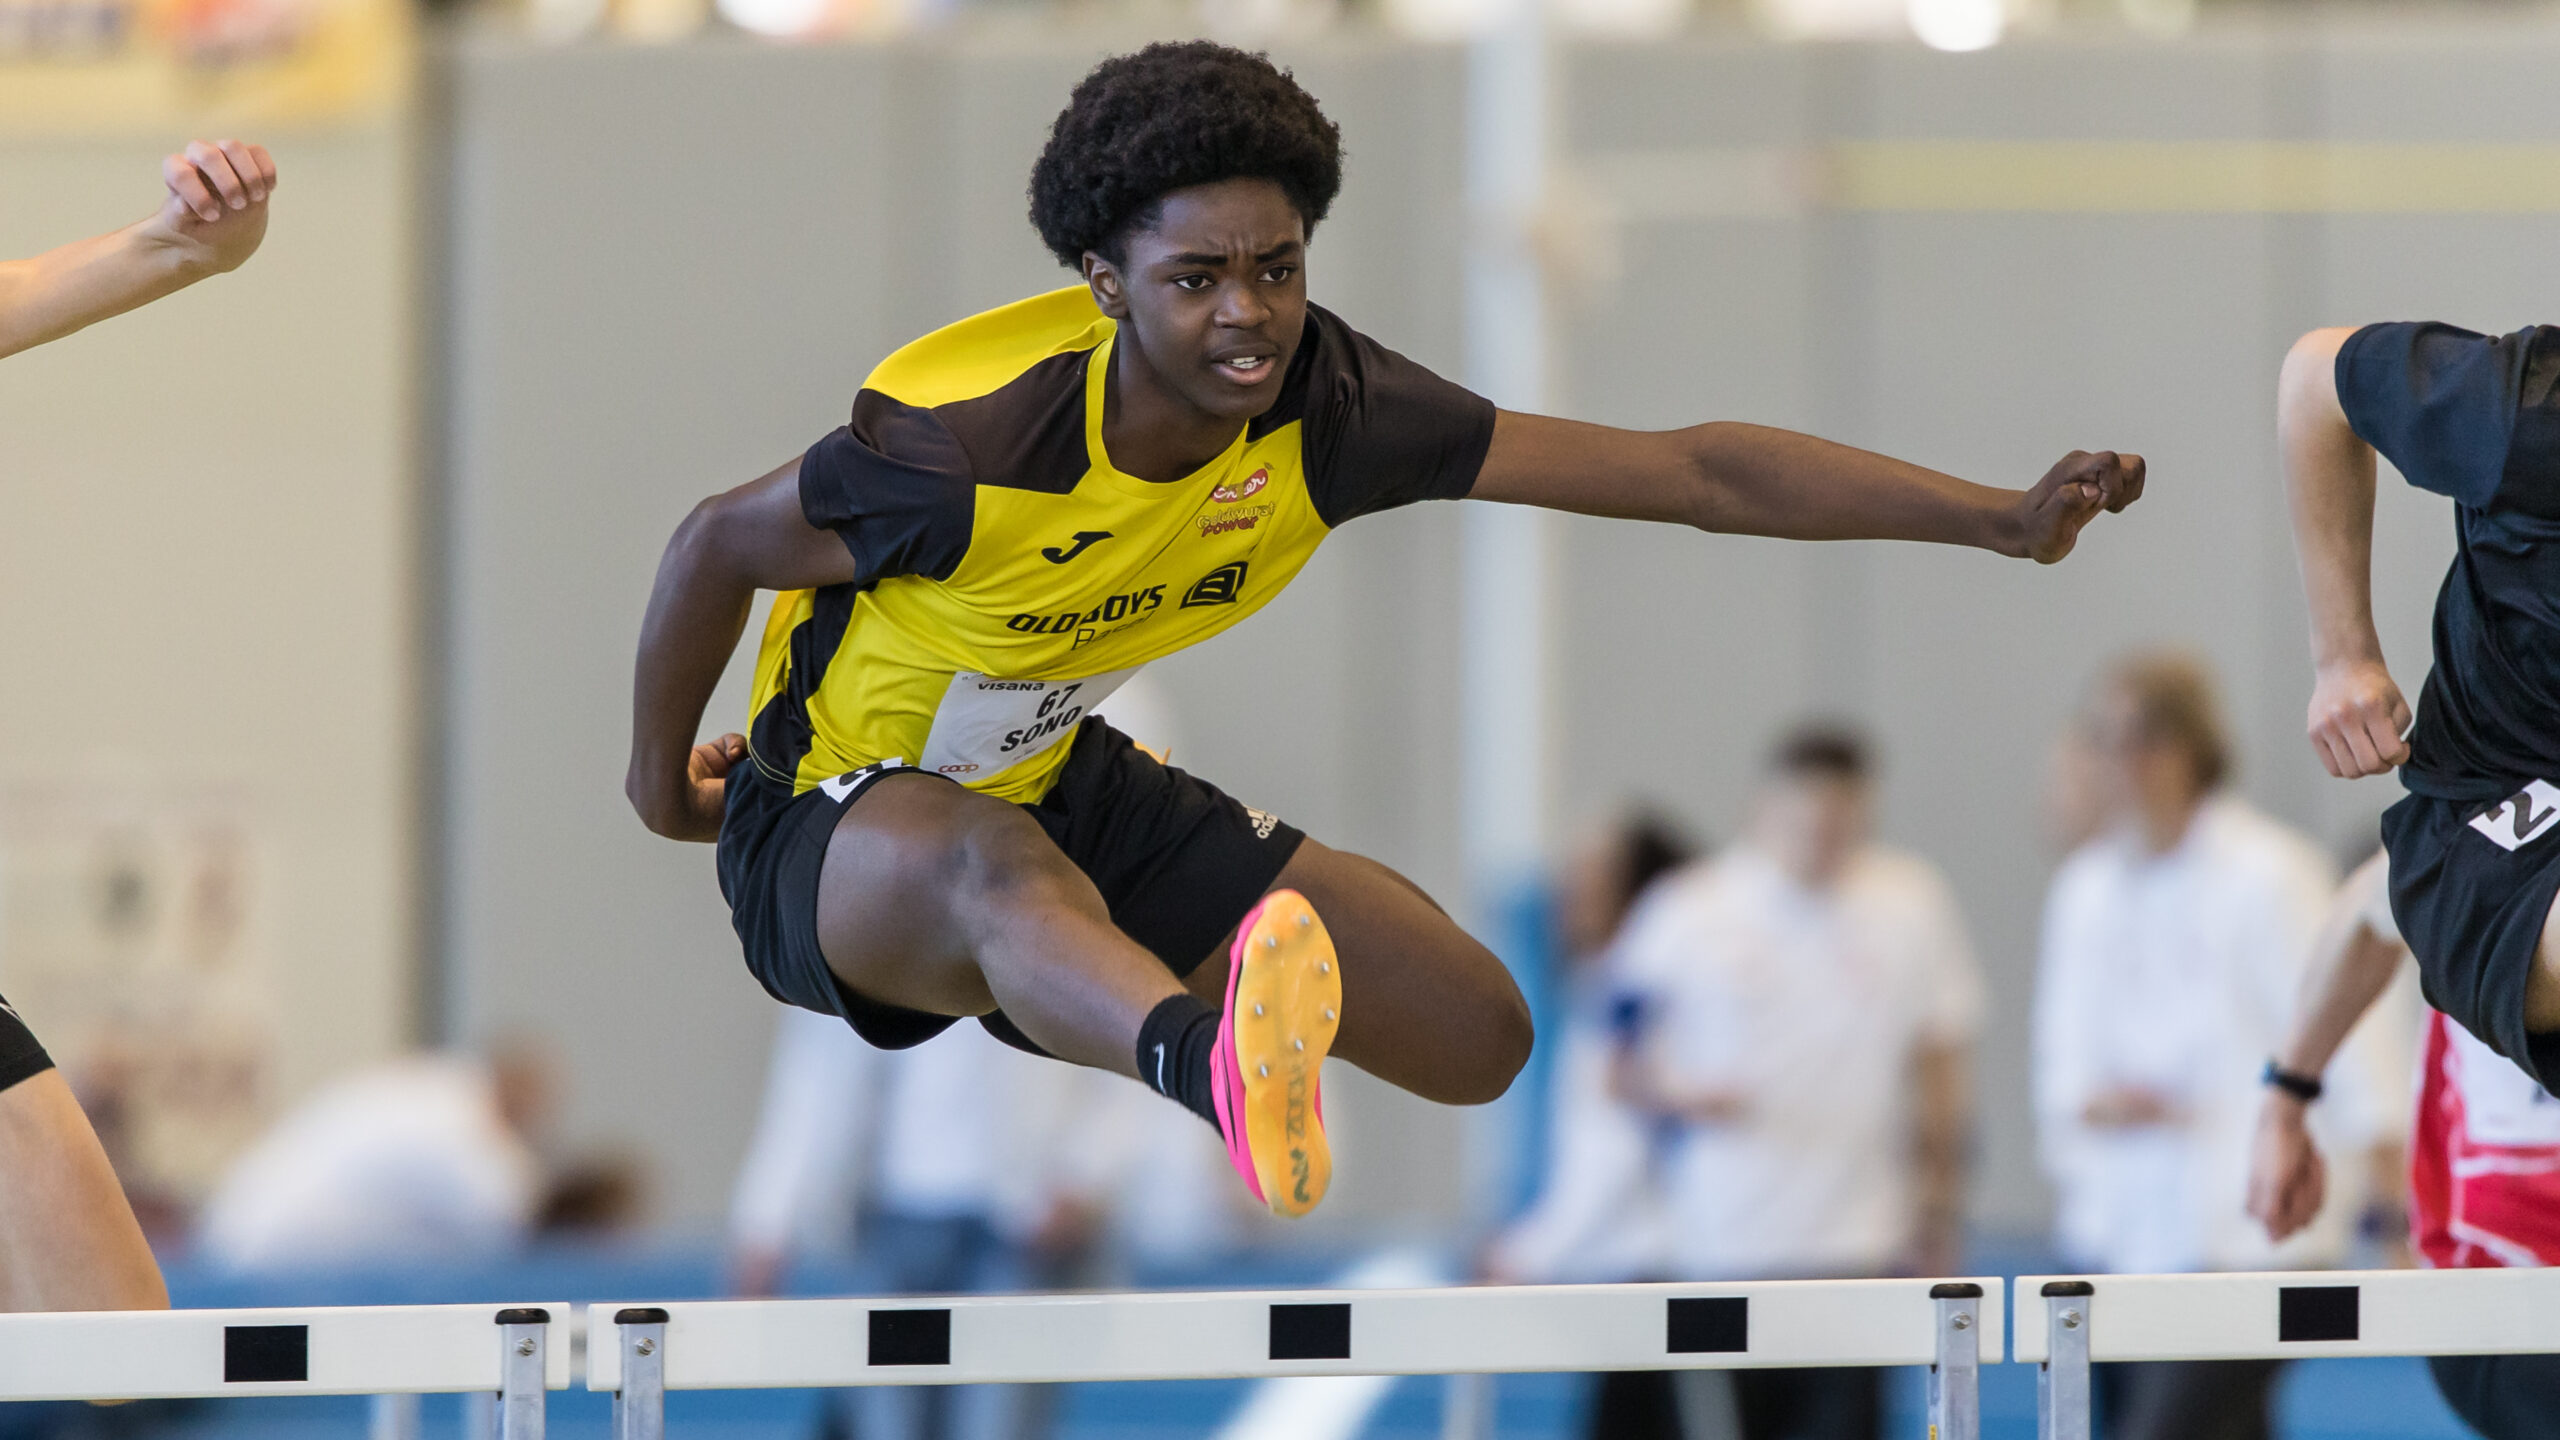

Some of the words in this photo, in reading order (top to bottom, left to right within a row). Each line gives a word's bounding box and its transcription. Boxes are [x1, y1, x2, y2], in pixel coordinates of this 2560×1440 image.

[1036, 682, 1083, 719] 67
[1000, 705, 1083, 752] SONO
[2484, 790, 2557, 840] 2
